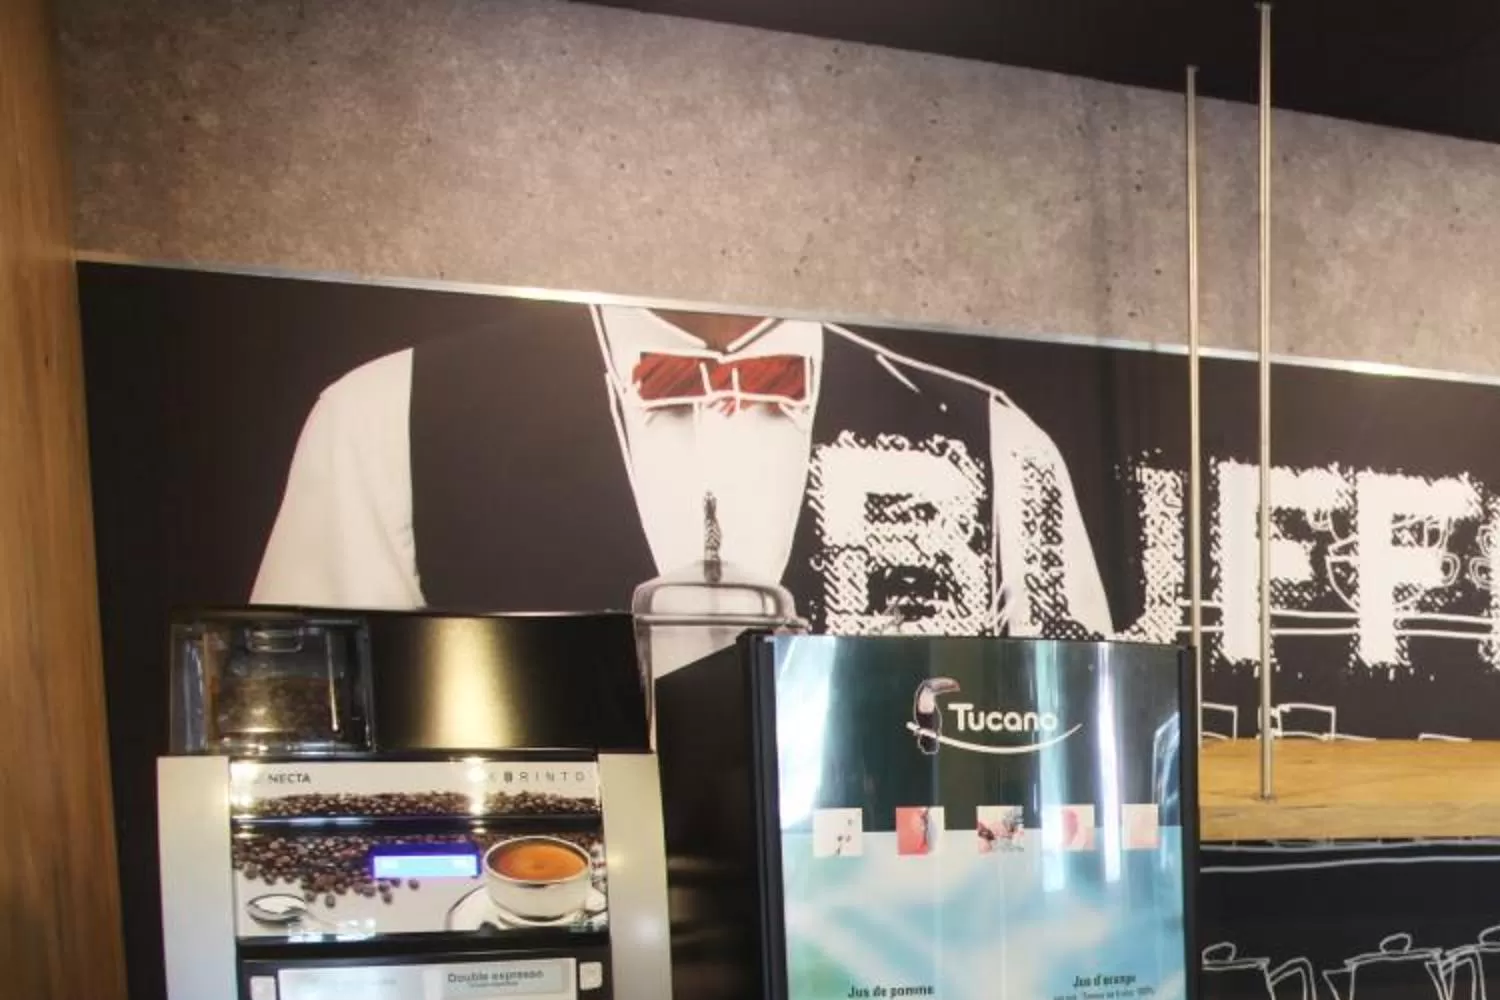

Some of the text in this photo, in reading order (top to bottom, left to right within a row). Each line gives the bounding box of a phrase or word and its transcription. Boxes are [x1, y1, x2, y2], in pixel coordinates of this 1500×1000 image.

[947, 703, 1058, 732] Tucano
[268, 772, 312, 784] NECTA
[447, 969, 544, 983] Double espresso
[847, 985, 935, 999] Jus de pomme
